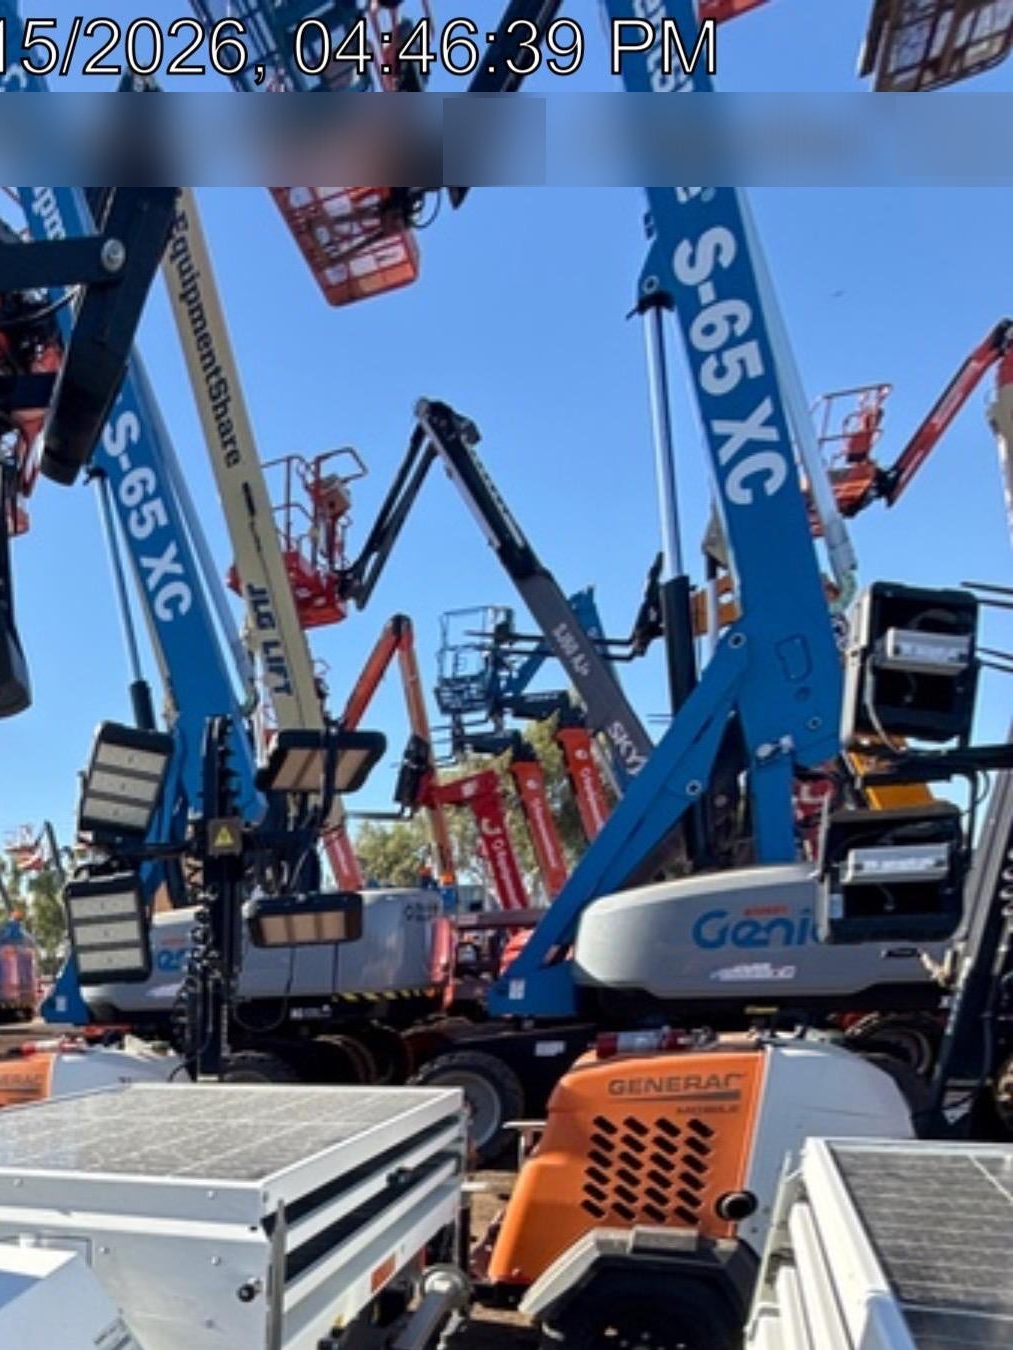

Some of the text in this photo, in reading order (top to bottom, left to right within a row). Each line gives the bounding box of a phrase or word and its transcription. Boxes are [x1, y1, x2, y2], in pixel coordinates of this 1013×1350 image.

[672, 226, 788, 506] S-65 XC
[102, 410, 192, 622] S-65 XC
[246, 582, 292, 696] JLG LIFT
[692, 908, 824, 949] Geni
[607, 1073, 748, 1096] GENERAC
